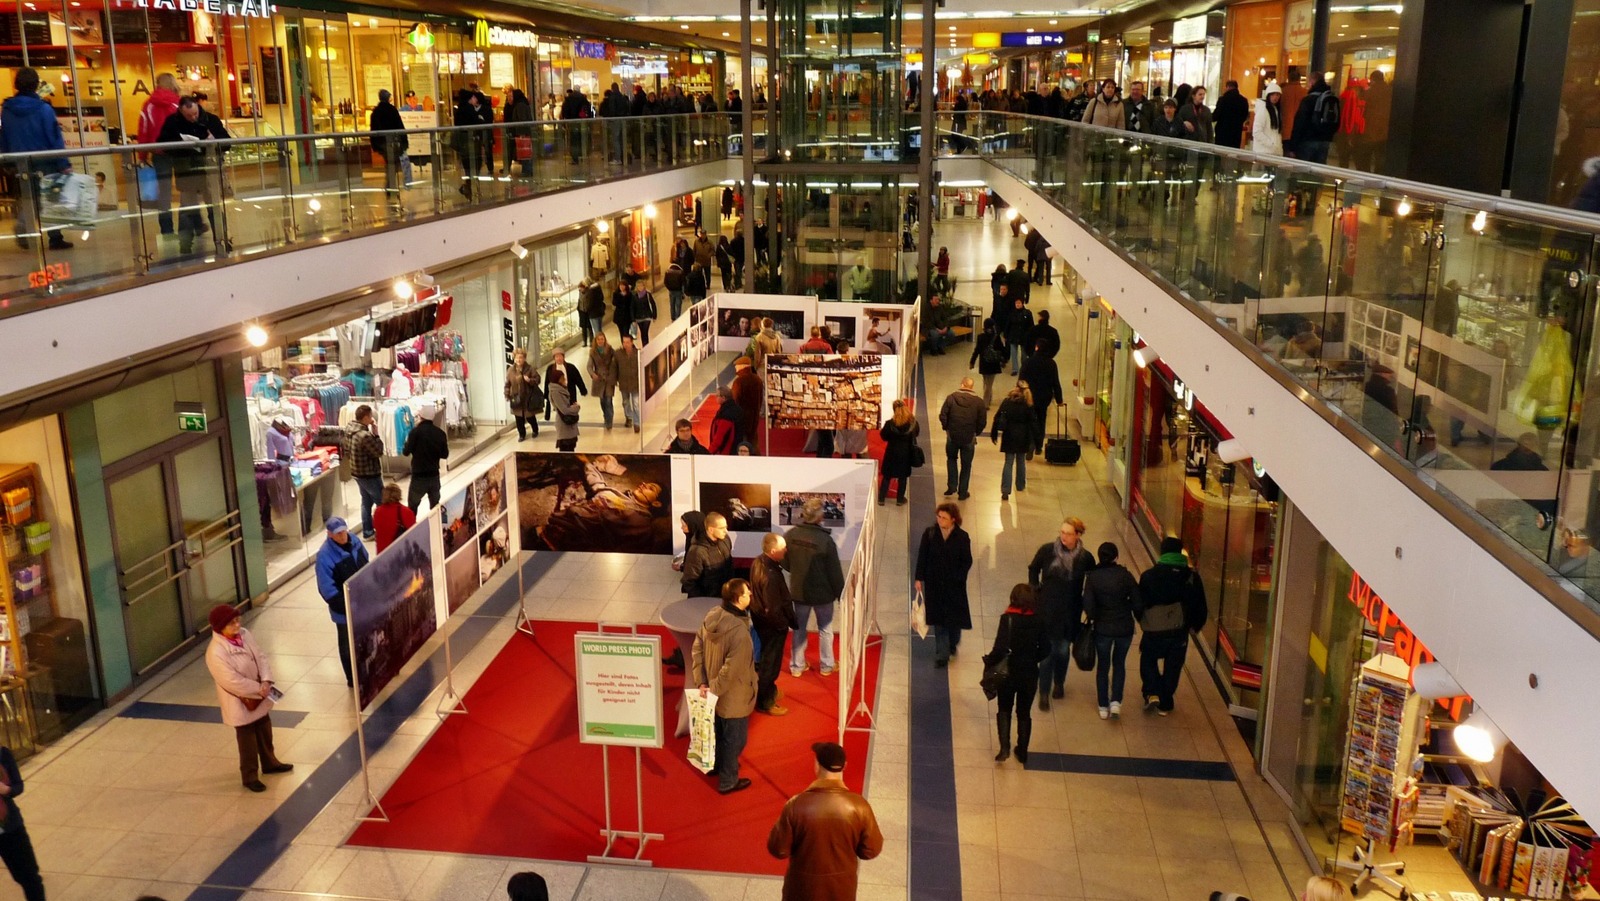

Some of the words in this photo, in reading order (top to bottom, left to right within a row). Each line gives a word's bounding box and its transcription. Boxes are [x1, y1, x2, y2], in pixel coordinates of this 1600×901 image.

[475, 19, 536, 48] McDonald's
[503, 317, 514, 371] EVER
[583, 644, 608, 653] WORLD
[608, 645, 628, 654] PRESS
[628, 646, 651, 655] PHOTO
